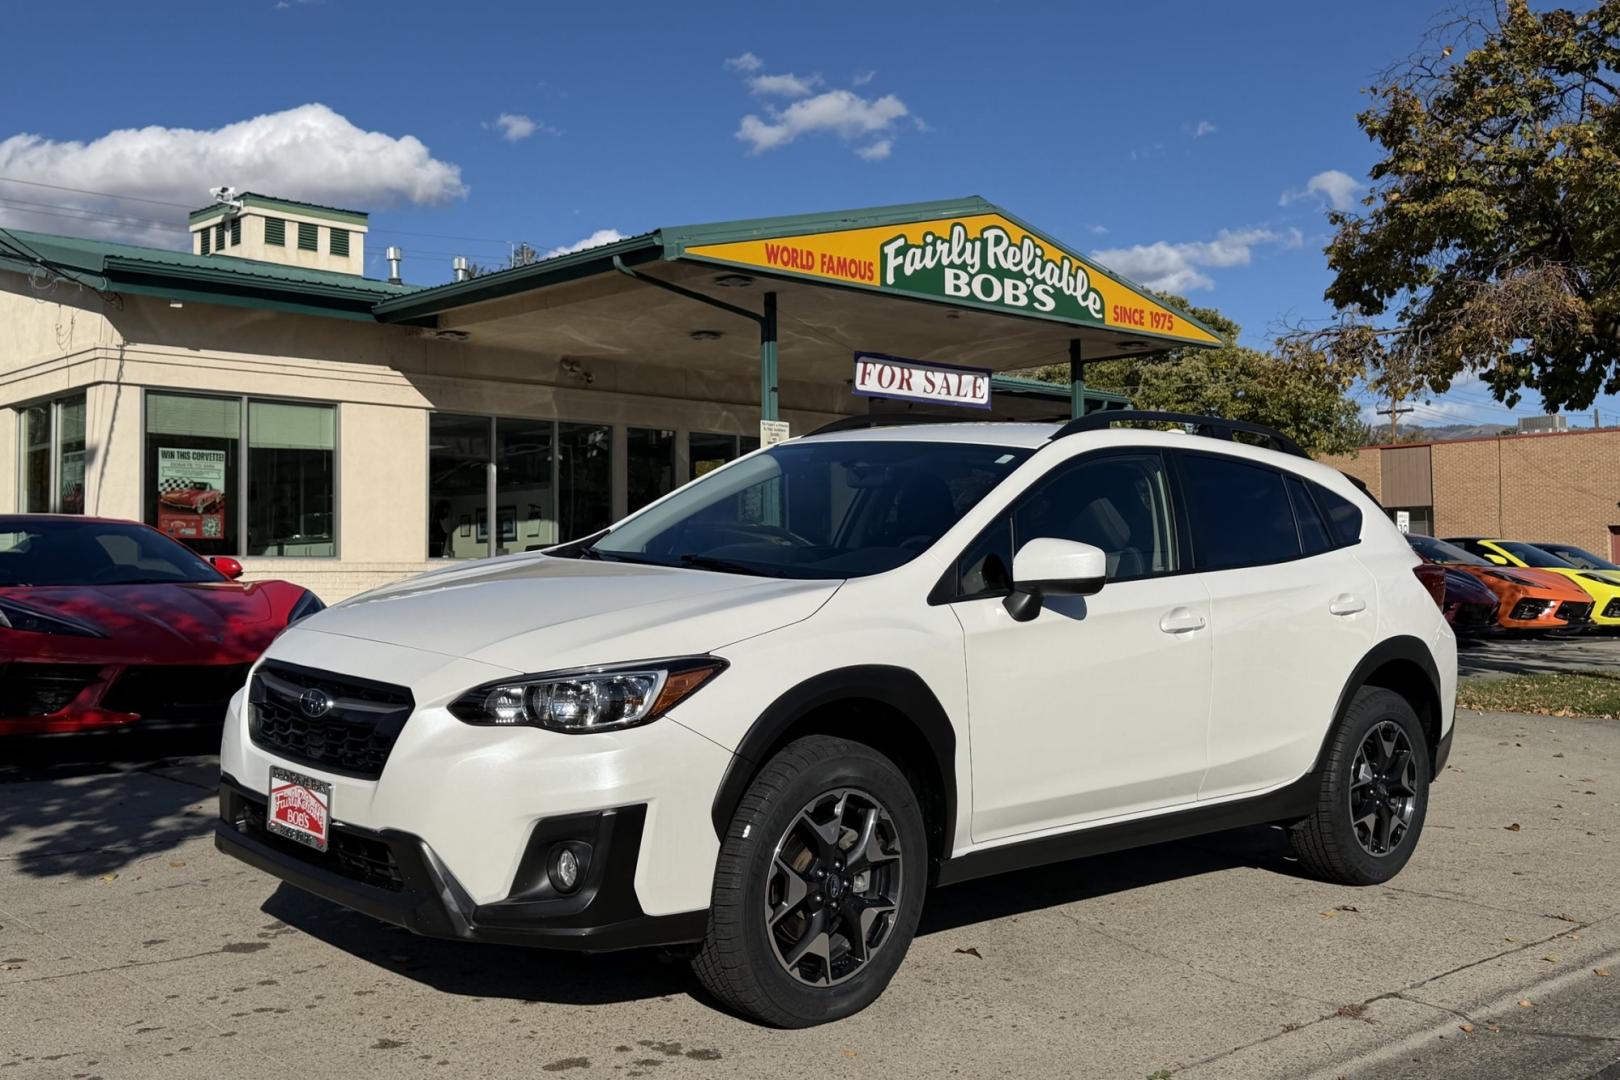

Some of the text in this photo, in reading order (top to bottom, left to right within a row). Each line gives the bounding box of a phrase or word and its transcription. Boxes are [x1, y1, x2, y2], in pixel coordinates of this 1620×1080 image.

[765, 243, 874, 281] WORLD FAMOUS
[884, 225, 1103, 319] Fairly Reliable
[944, 267, 1056, 312] BOB'S
[1113, 304, 1174, 331] SINCE 1975
[859, 361, 985, 400] FOR SALE
[161, 450, 175, 460] WIN
[176, 451, 191, 460] THIS
[287, 810, 310, 829] BOB'S
